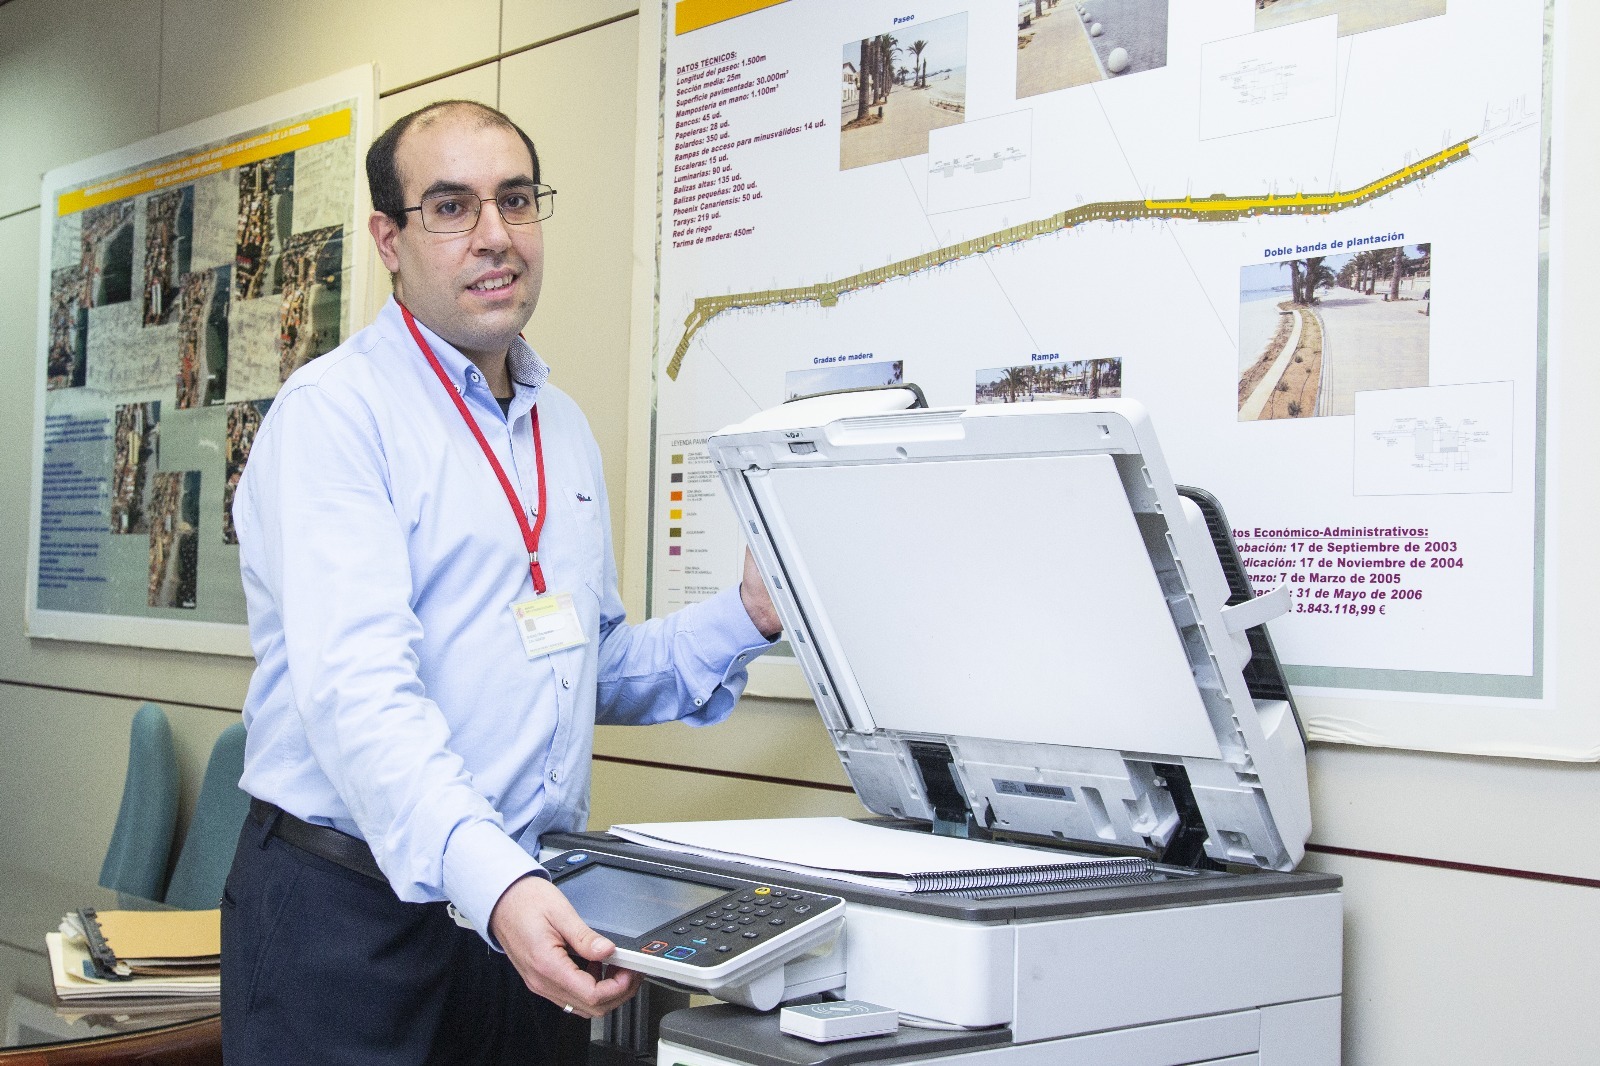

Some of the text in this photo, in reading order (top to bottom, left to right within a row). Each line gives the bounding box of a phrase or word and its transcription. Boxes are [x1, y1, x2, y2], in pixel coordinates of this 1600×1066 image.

[676, 62, 699, 74] DATOS
[676, 54, 766, 85] Longitud del paseo: 1.500m
[676, 73, 741, 96] Sección media: 25m
[676, 92, 708, 107] Superficie
[710, 80, 754, 99] pavimentada:
[728, 94, 750, 104] mano:
[676, 110, 722, 128] Bancos: 45 ud.
[675, 120, 730, 140] Papeleras: 28 ud.
[674, 130, 730, 150] Bolardos: 350 ud.
[674, 150, 700, 162] Rampas
[711, 142, 734, 153] acceso
[736, 138, 752, 150] para
[754, 124, 802, 143] minusválidos:
[804, 122, 812, 130] 14
[814, 118, 826, 128] ud.
[674, 154, 728, 172] Escaleras: 15 ud.
[674, 164, 732, 183] Luminarias: 90 ud.
[674, 173, 742, 194] Balizas altas: 135 ud.
[674, 181, 758, 205] Balizas pequeñas: 200 ud.
[673, 191, 762, 216] Phoenix Canariensis: 50 ud.
[673, 211, 721, 228] Tarays: 219 ud.
[672, 224, 712, 238] Red de riego
[672, 238, 694, 249] Tarima
[696, 236, 704, 244] de
[705, 231, 732, 243] madera:
[1264, 232, 1404, 258] Doble banda de plantación
[838, 354, 846, 362] de
[848, 352, 873, 360] madera
[1232, 526, 1428, 538] tos Económico-Administrativos:
[1237, 542, 1458, 554] obación: 17 de Septiembre de 2003
[1300, 558, 1314, 568] 17
[1318, 558, 1333, 568] de
[1338, 558, 1406, 568] Noviembre
[1410, 558, 1426, 568] de
[1430, 558, 1464, 568] 2004
[1280, 572, 1287, 582] 7
[1290, 572, 1305, 582] de
[1310, 573, 1346, 583] Marzo
[1350, 573, 1366, 583] de
[1370, 573, 1401, 584] 2005
[1296, 588, 1423, 600] 31 de Mayo de 2006
[1296, 603, 1386, 616] 3.843.118,99 €
